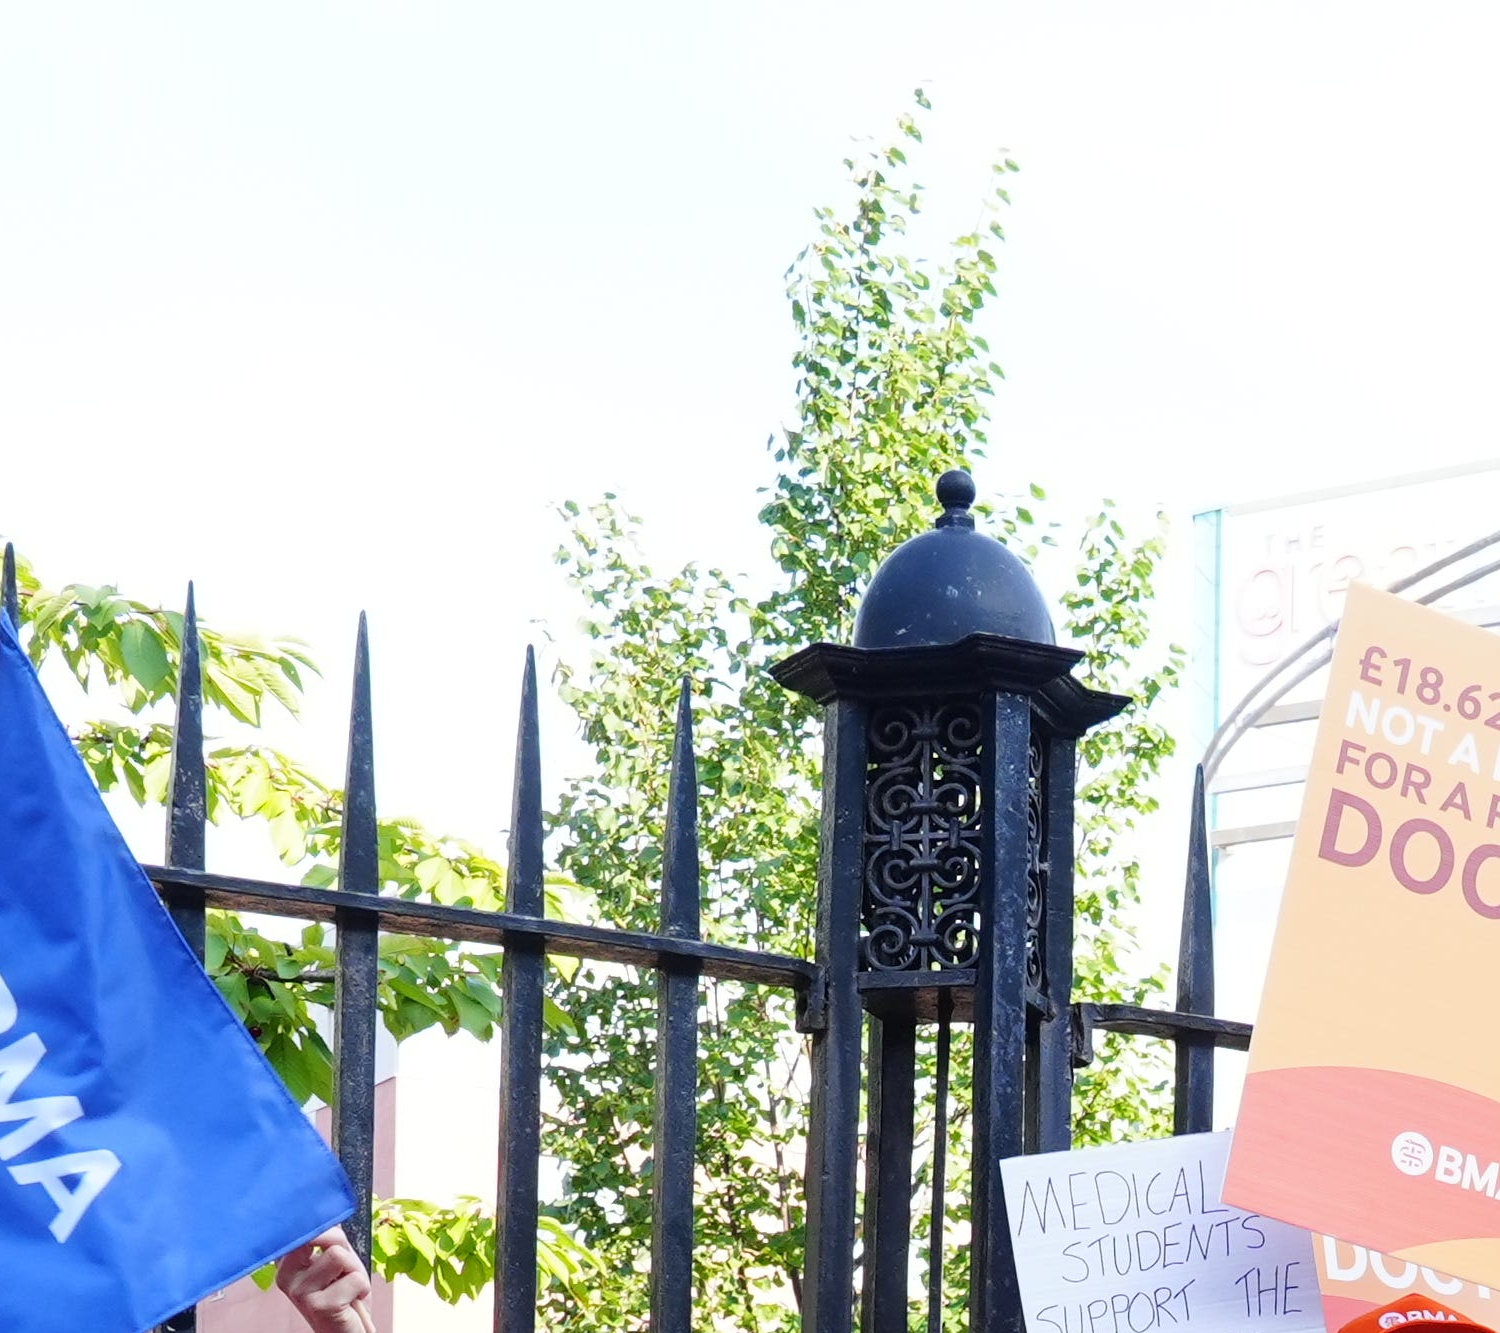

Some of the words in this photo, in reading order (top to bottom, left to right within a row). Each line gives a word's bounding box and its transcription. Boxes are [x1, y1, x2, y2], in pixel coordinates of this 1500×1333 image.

[1346, 691, 1444, 755] NOT
[1448, 733, 1480, 774] A
[1336, 739, 1431, 805] FOR
[1439, 782, 1471, 821] A
[1018, 1160, 1230, 1236] MEDICAL
[1062, 1215, 1264, 1282] STUDENTS
[1235, 1262, 1301, 1316] THE
